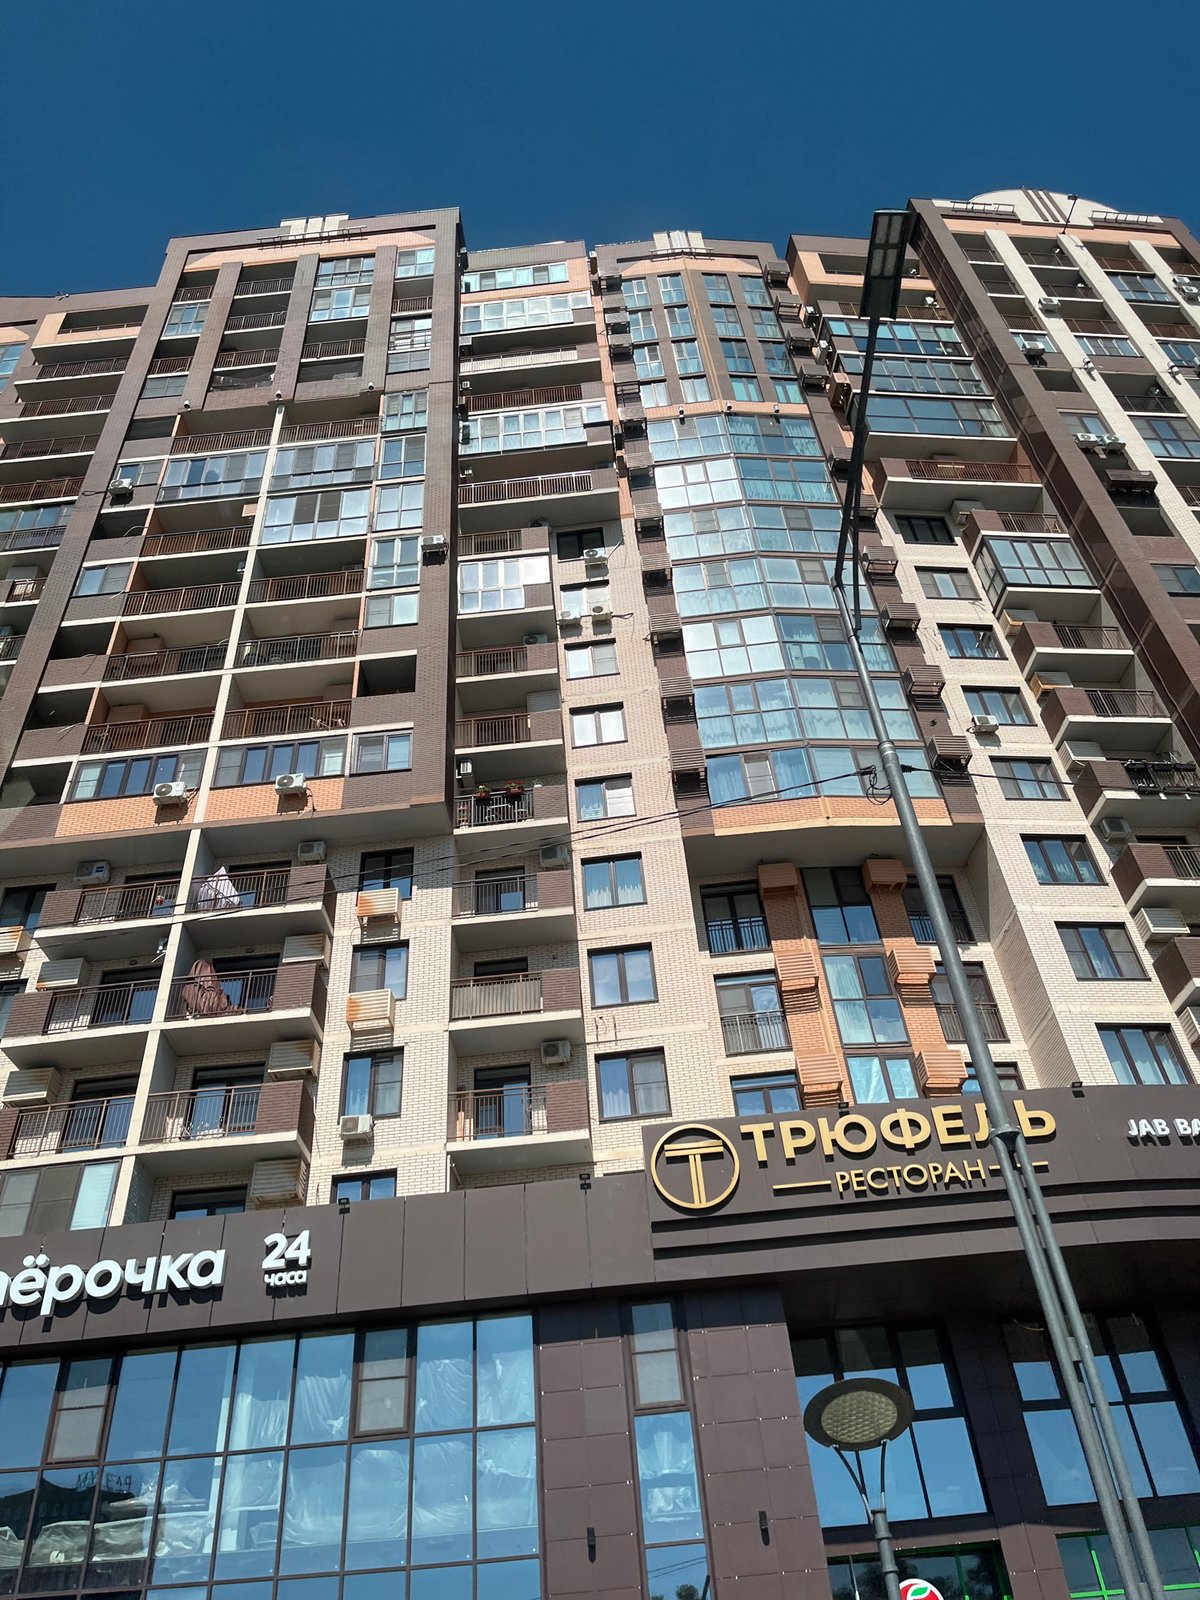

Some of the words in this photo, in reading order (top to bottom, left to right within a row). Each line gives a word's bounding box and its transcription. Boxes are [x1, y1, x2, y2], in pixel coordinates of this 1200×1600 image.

[1127, 1118, 1171, 1137] JAB
[835, 1159, 987, 1193] РЕСТОРАН
[261, 1229, 312, 1269] 24
[0, 1249, 226, 1316] ёрочка
[263, 1270, 309, 1287] часа
